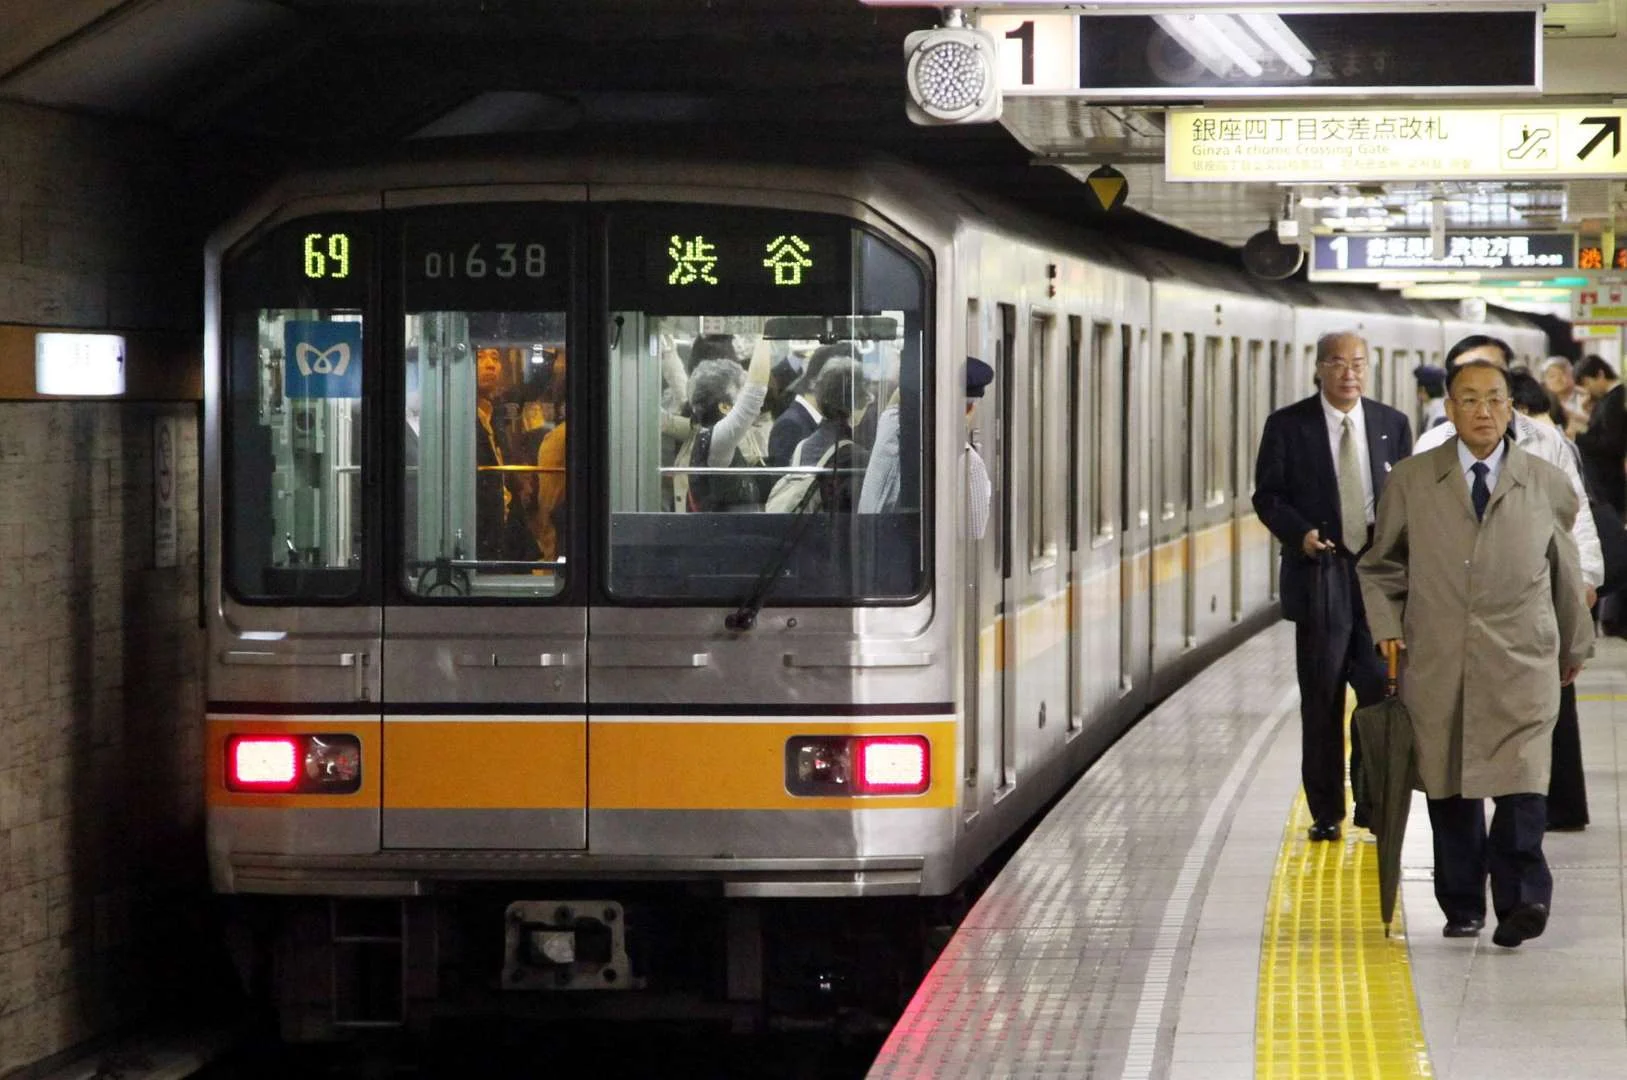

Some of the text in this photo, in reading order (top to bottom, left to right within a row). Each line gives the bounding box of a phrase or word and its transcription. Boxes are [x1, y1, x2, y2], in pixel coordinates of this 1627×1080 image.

[1005, 20, 1034, 85] 1
[1191, 117, 1449, 142] 銀座四丁目交差点改札
[1191, 144, 1231, 156] Ginza
[1295, 144, 1353, 158] Crossing
[1358, 144, 1391, 156] Gate
[304, 233, 349, 278] 69
[668, 234, 813, 285] 渋谷
[1329, 236, 1349, 270] 1
